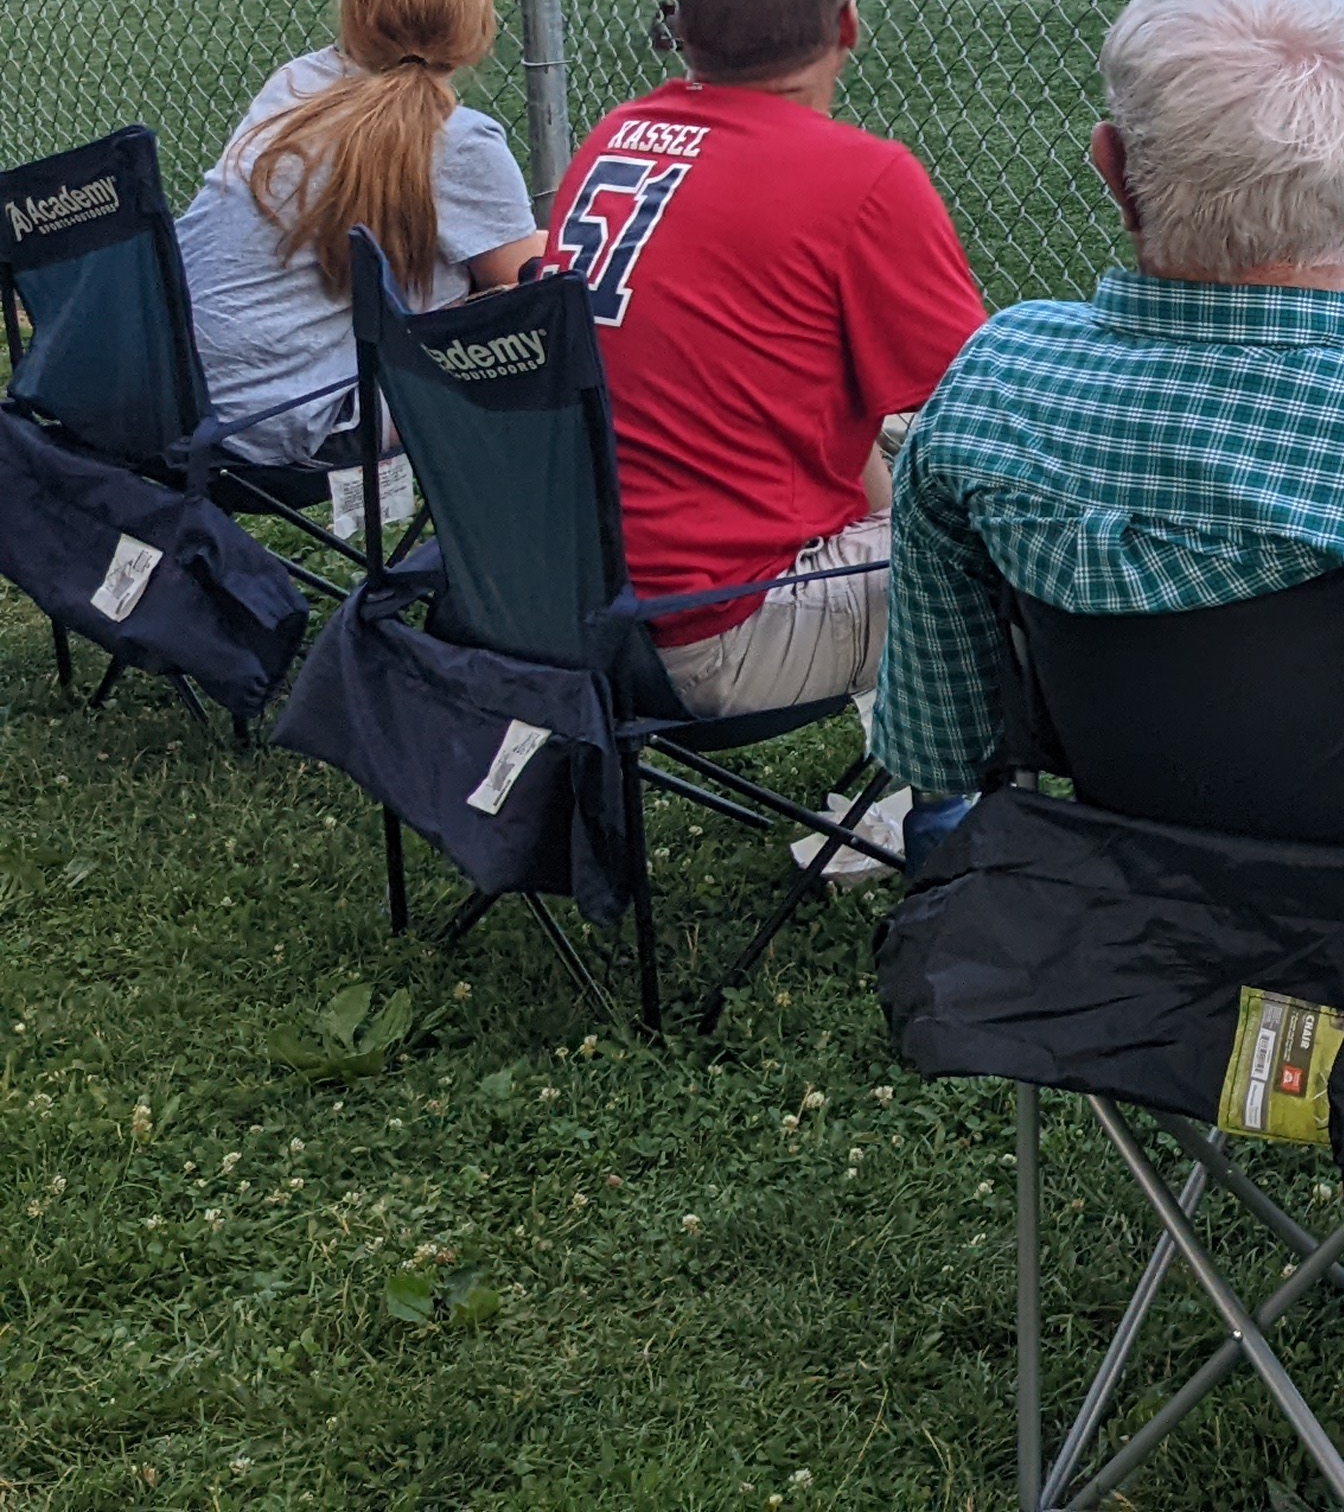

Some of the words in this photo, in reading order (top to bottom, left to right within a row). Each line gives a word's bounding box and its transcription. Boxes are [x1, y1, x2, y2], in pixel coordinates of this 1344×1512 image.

[608, 120, 711, 157] KASSEL
[538, 155, 692, 327] 51
[421, 329, 547, 371] ademy
[1299, 1014, 1316, 1050] CHAIR
